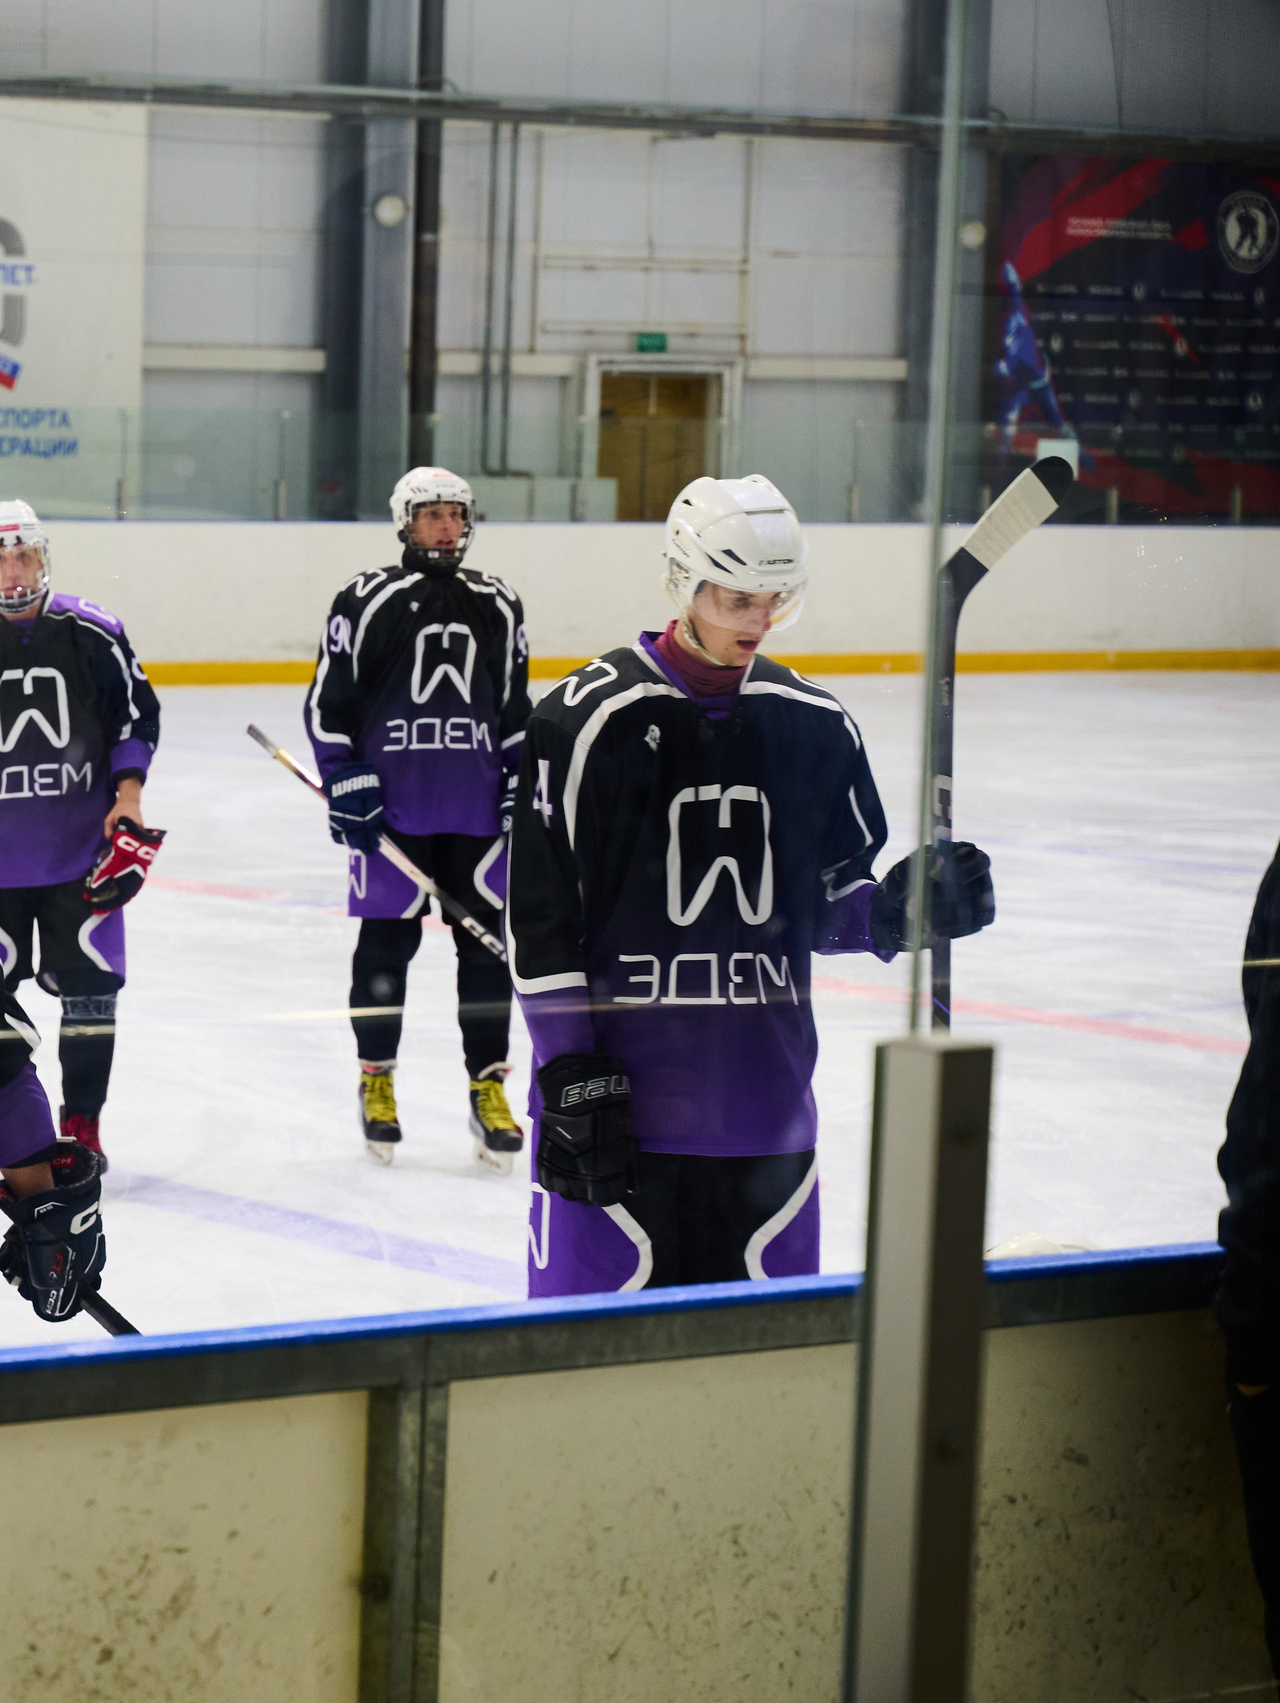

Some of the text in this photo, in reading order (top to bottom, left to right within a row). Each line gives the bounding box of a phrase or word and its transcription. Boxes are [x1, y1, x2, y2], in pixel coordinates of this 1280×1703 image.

[382, 717, 492, 753] ЭДЕМ
[331, 773, 380, 799] WARR
[116, 834, 158, 861] CC
[612, 952, 800, 1006] ЭДЕМ
[560, 1074, 632, 1108] BAU
[52, 1157, 72, 1166] CM
[45, 1288, 58, 1315] CCM
